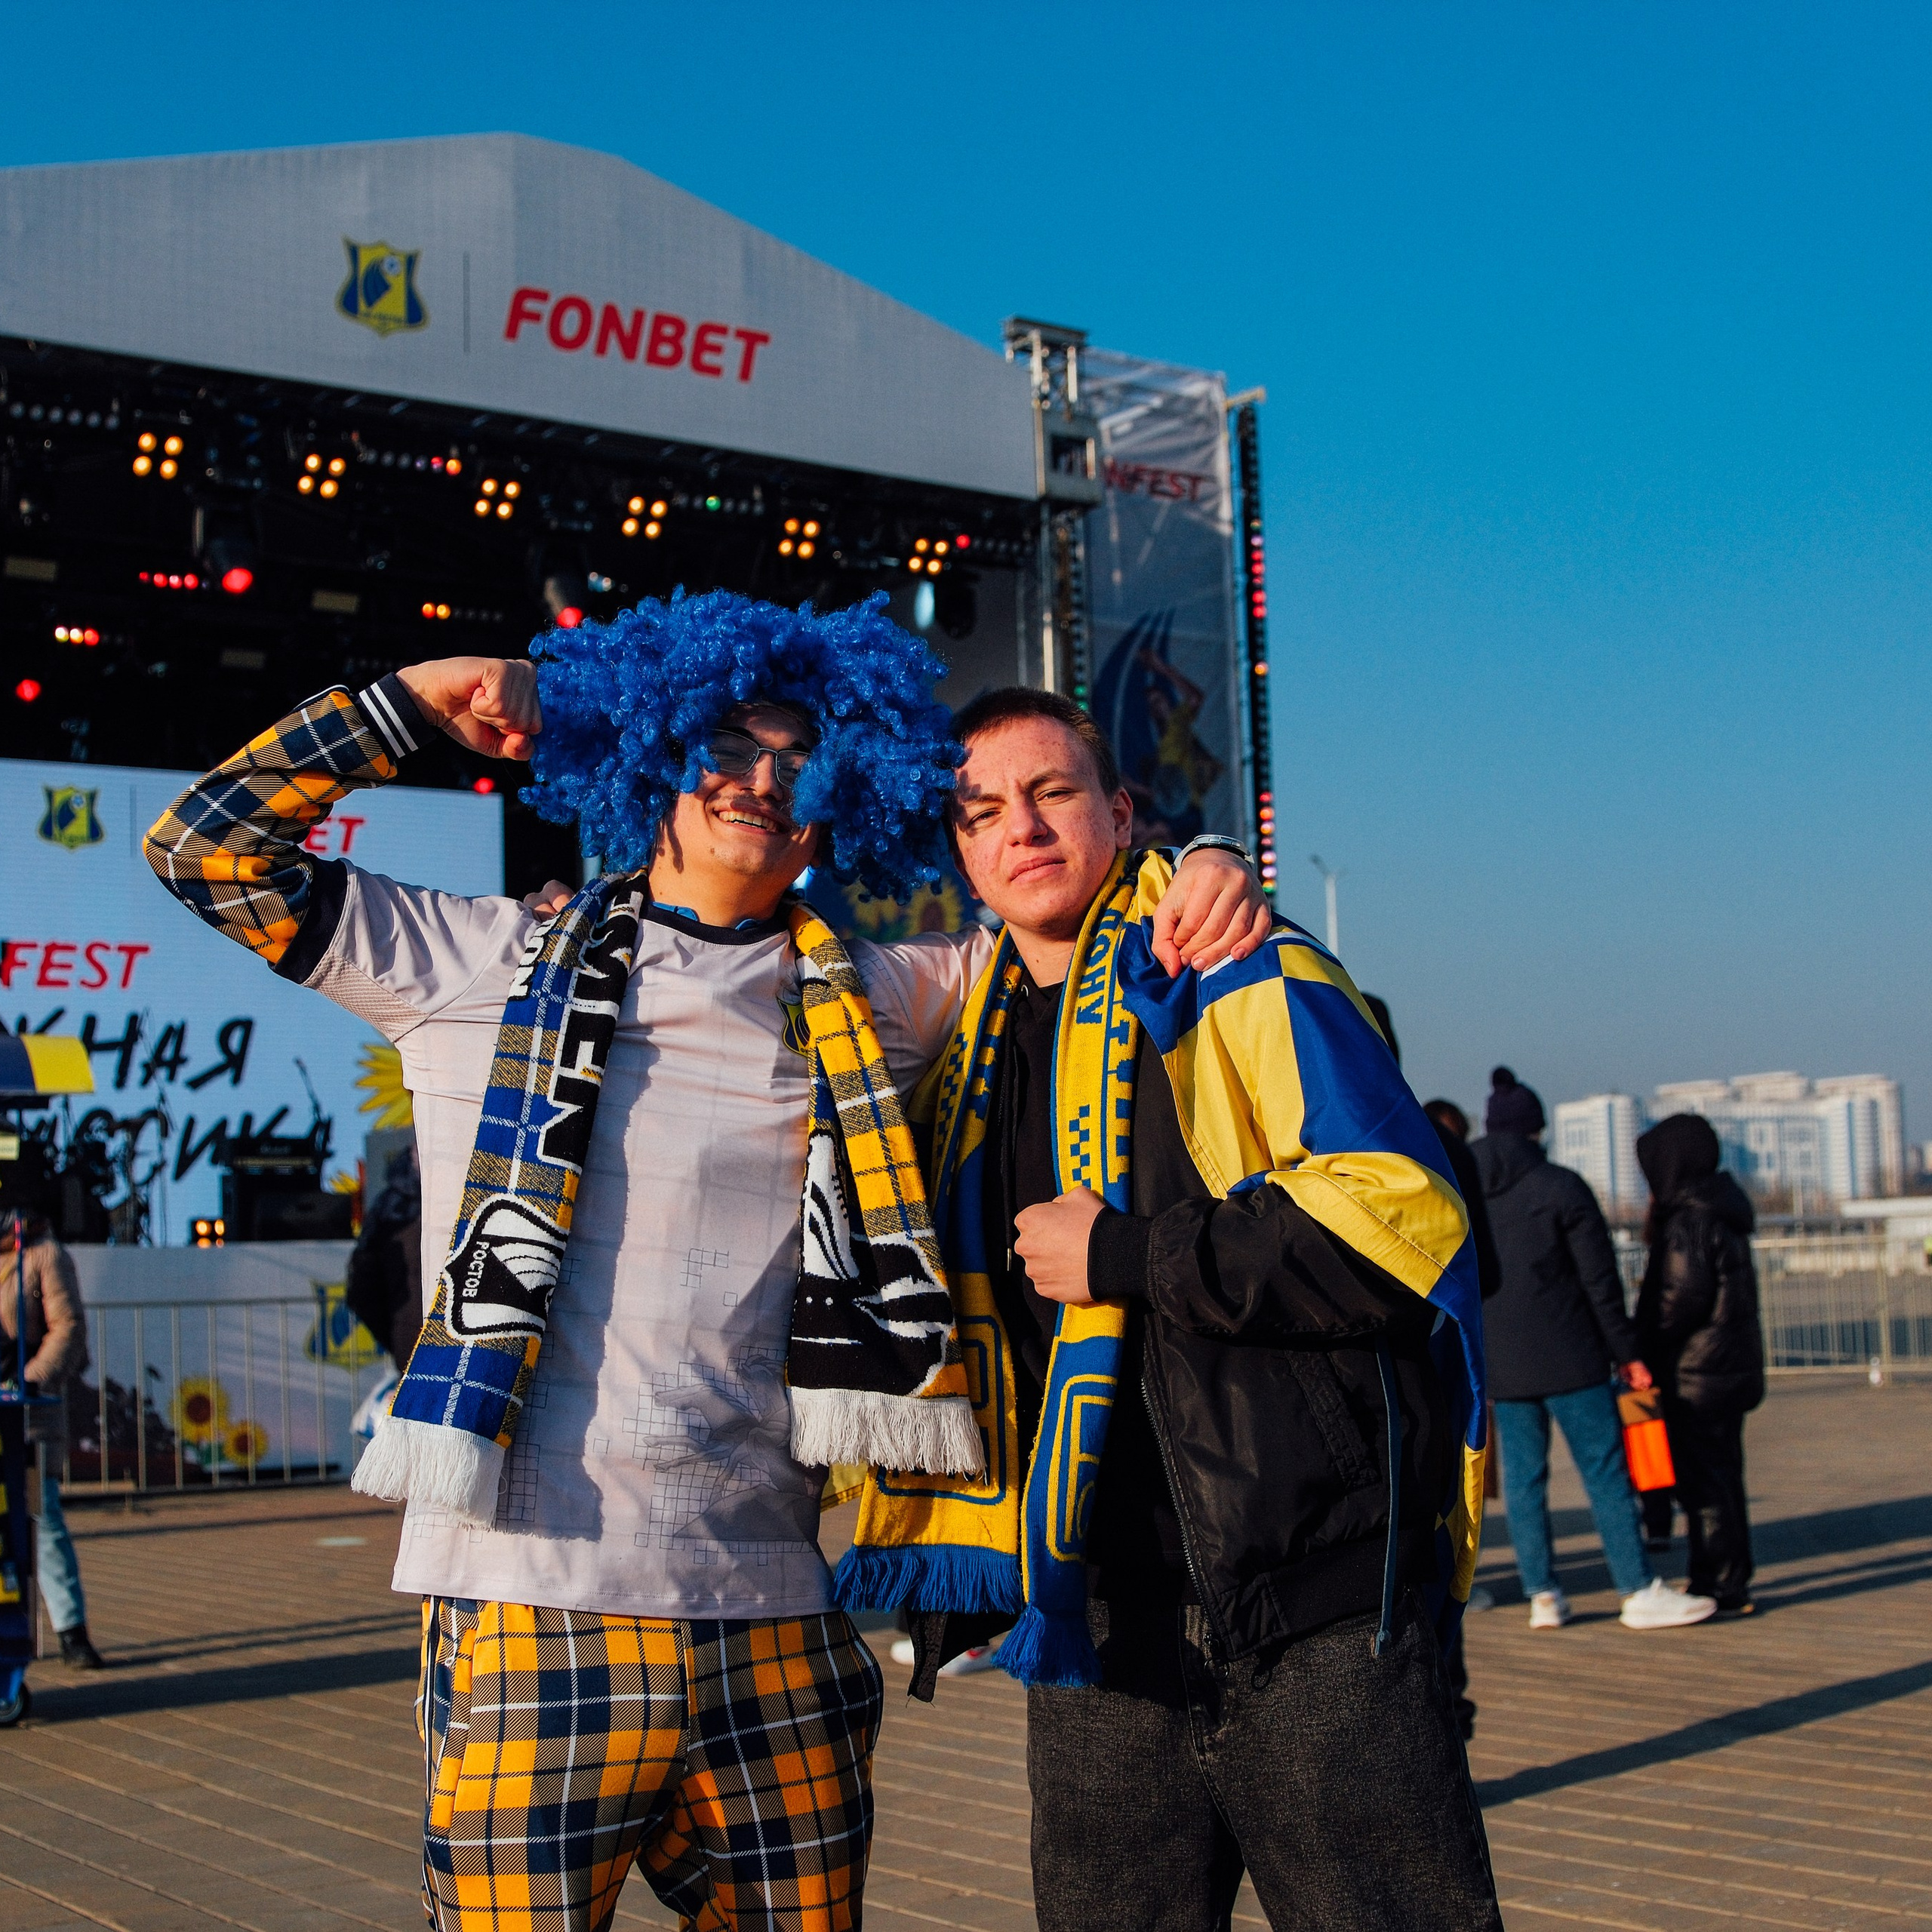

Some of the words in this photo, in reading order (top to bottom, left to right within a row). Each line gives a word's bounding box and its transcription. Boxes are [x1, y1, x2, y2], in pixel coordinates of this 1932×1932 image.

[504, 287, 771, 383] FONBET
[1, 942, 149, 989] FEST
[461, 1241, 490, 1298] РОСТОВ
